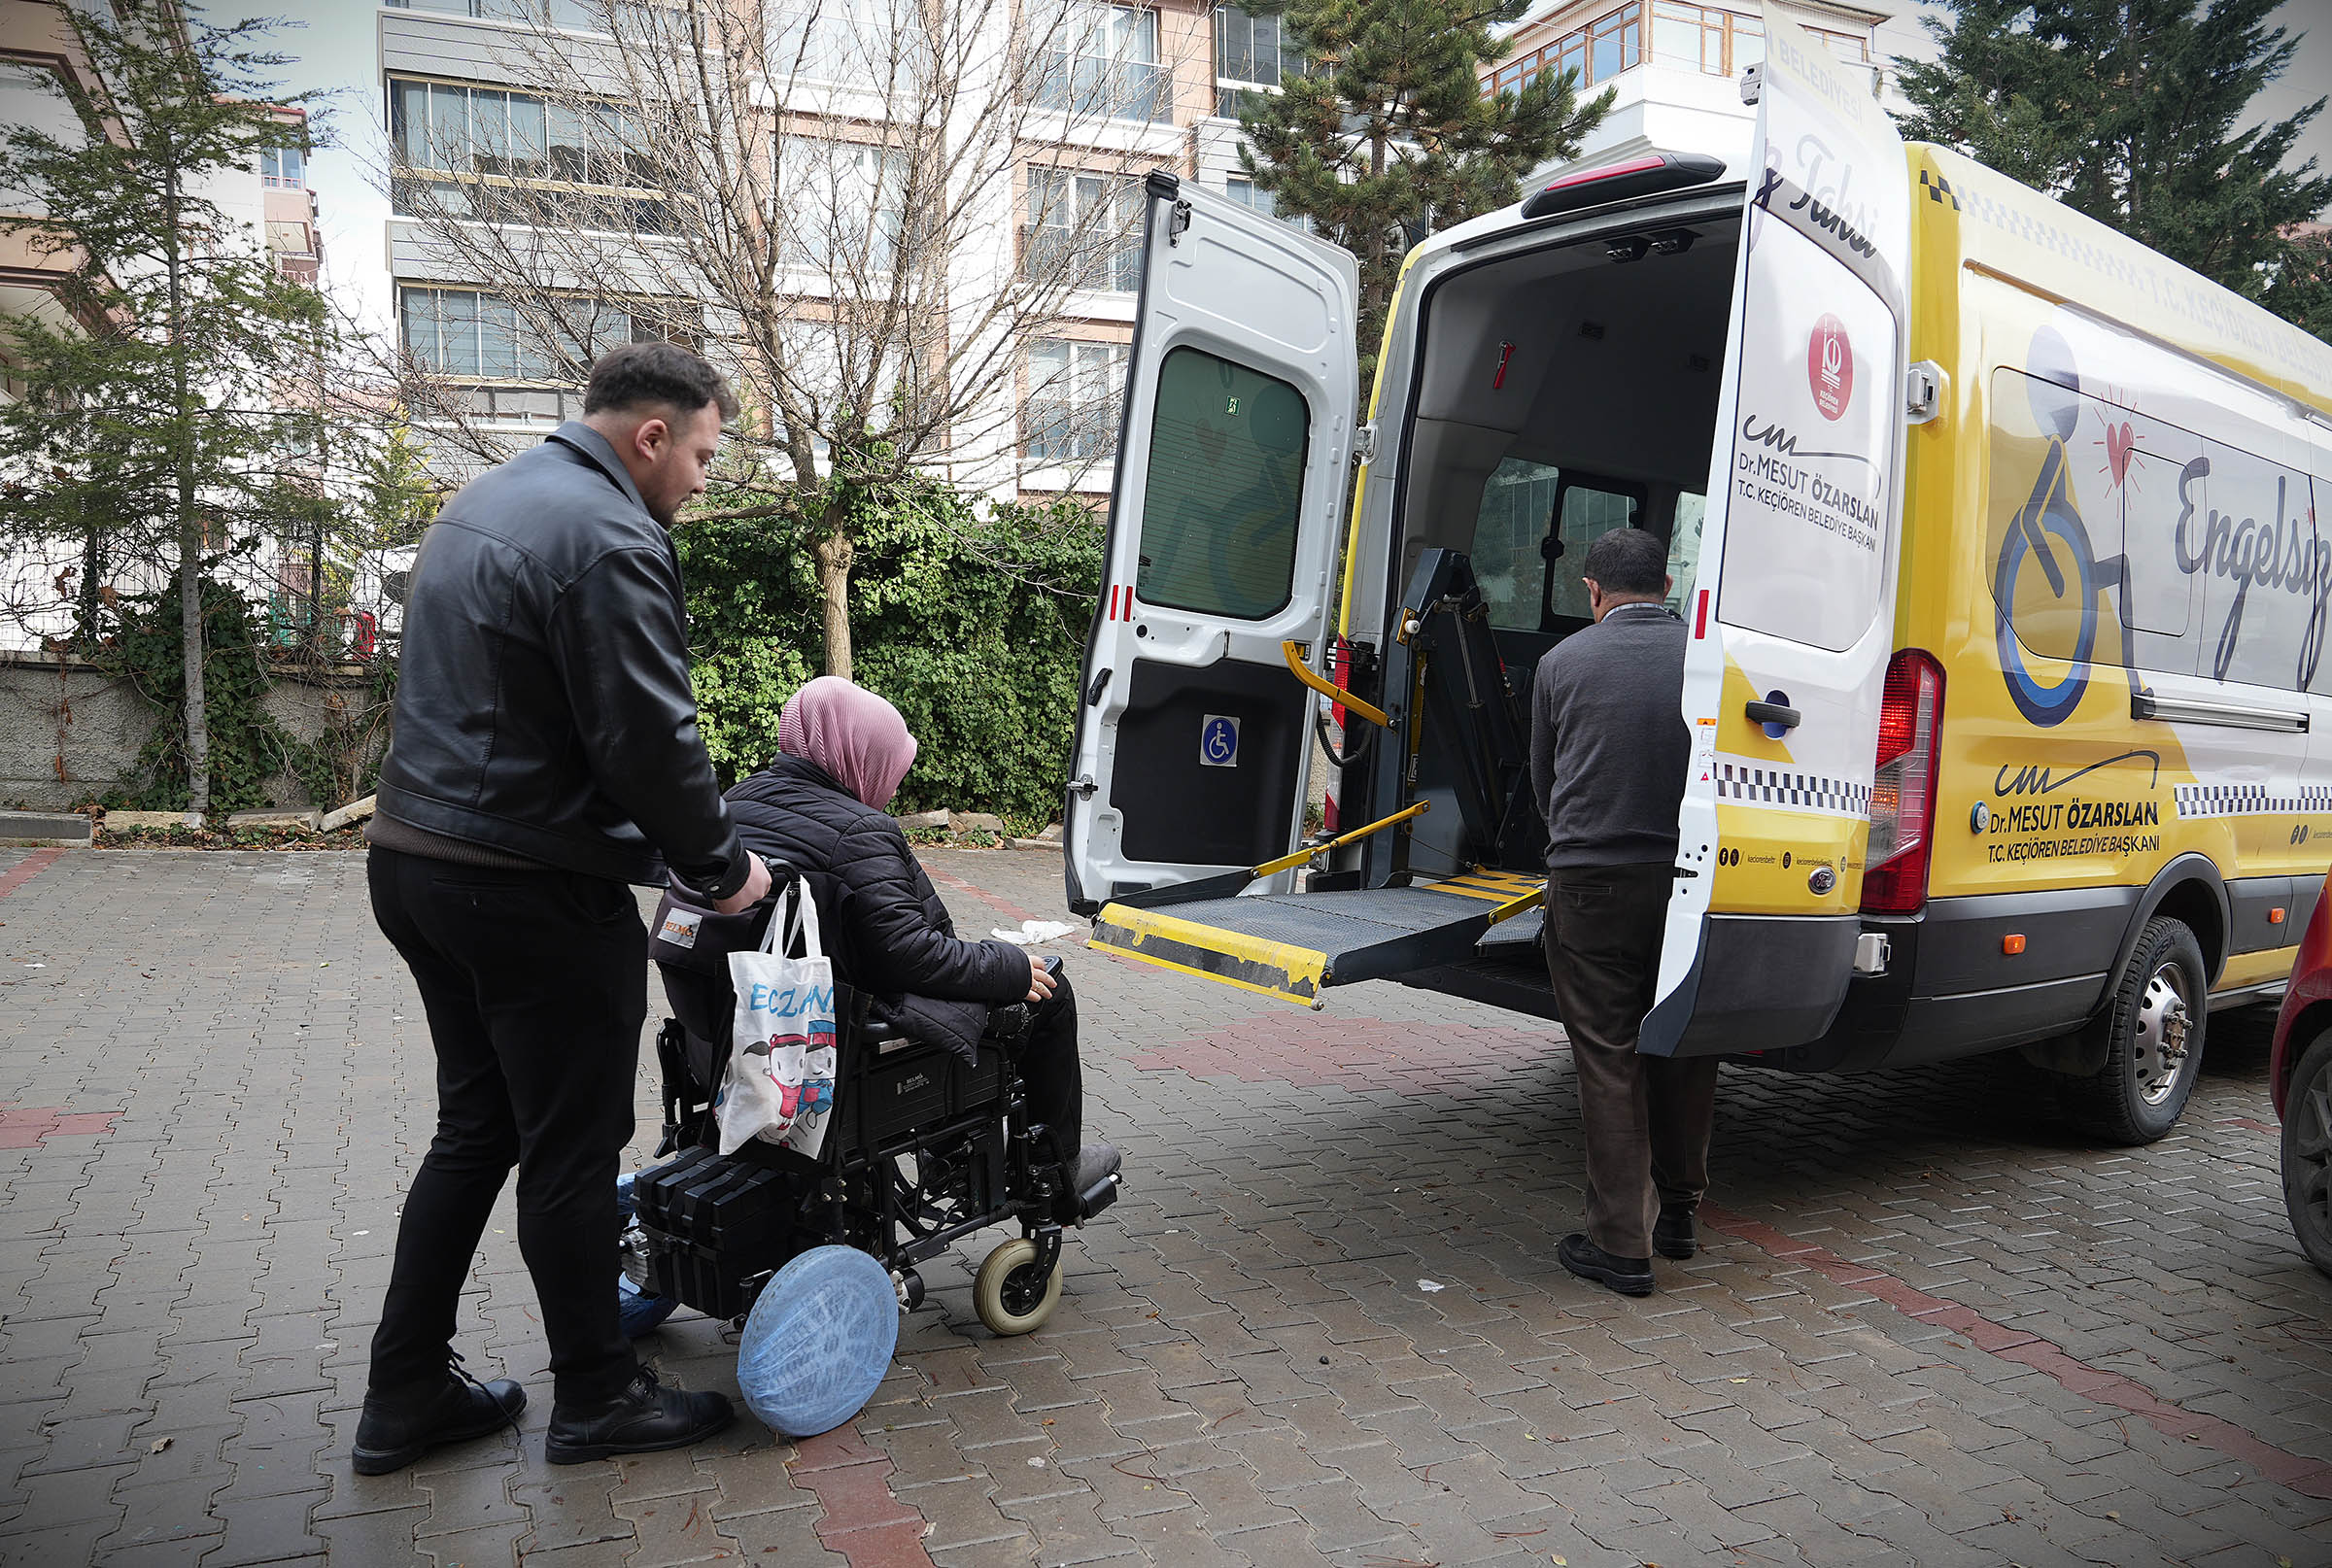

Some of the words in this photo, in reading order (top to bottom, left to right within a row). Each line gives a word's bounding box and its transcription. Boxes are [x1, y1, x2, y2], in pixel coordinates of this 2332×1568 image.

[1738, 479, 1756, 500] T.C.
[1758, 487, 1807, 519] KEÇİÖREN
[1808, 507, 1847, 537] BELEDİYE
[1848, 526, 1876, 552] BAŞKANI
[1812, 473, 1879, 530] ÖZARSLAN
[2067, 798, 2159, 829] ÖZARSLAN
[1988, 844, 2006, 863] T.C.
[2006, 836, 2060, 865] KEÇİÖREN
[2061, 833, 2110, 856] BELEDİYE
[2110, 835, 2160, 857] BAŞKANI
[1816, 872, 1833, 888] Ford
[750, 983, 836, 1017] ECZAN
